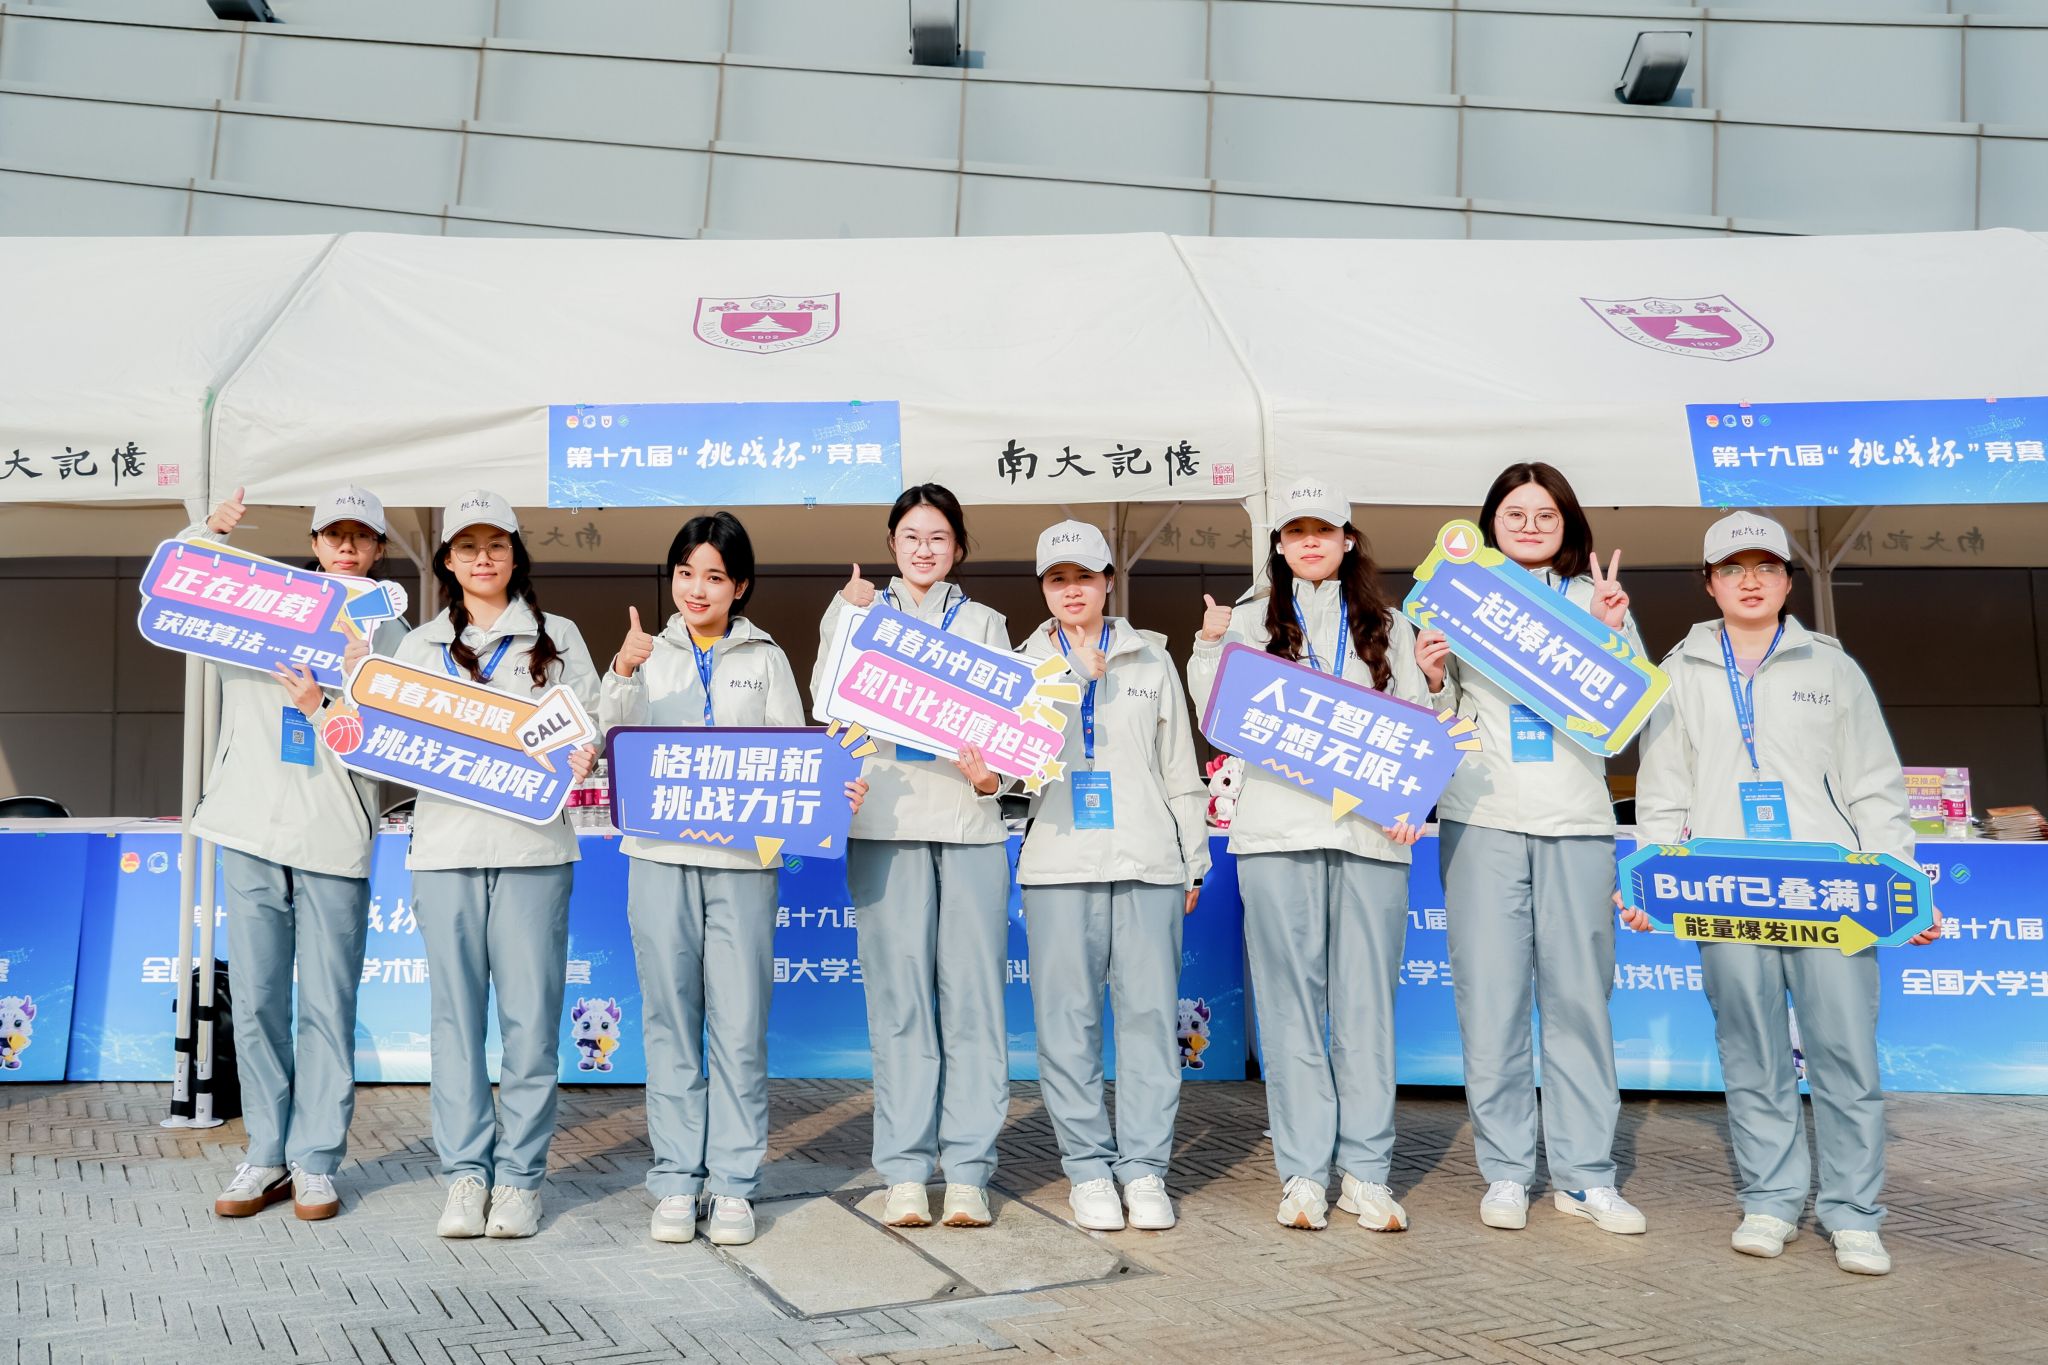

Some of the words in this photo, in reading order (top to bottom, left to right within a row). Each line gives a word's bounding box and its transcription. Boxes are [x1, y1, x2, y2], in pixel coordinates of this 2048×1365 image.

[1689, 340, 1721, 348] 1902
[160, 565, 319, 624] 正在加载
[872, 616, 1022, 702] 青春为中国式
[1450, 577, 1628, 710] 一起捧杯吧!
[367, 672, 516, 735] 青春不设限
[522, 711, 572, 749] CALL
[850, 661, 1053, 771] 现代化挺膺担当
[1251, 677, 1435, 761] 人工智能+
[362, 723, 559, 804] 挑战无极限!
[650, 743, 823, 784] 格物鼎新
[1239, 707, 1423, 797] 梦想无限+
[651, 785, 822, 825] 挑战力行
[1653, 872, 1879, 913] Buff已叠满!
[1684, 916, 1839, 944] 能量爆发ING
